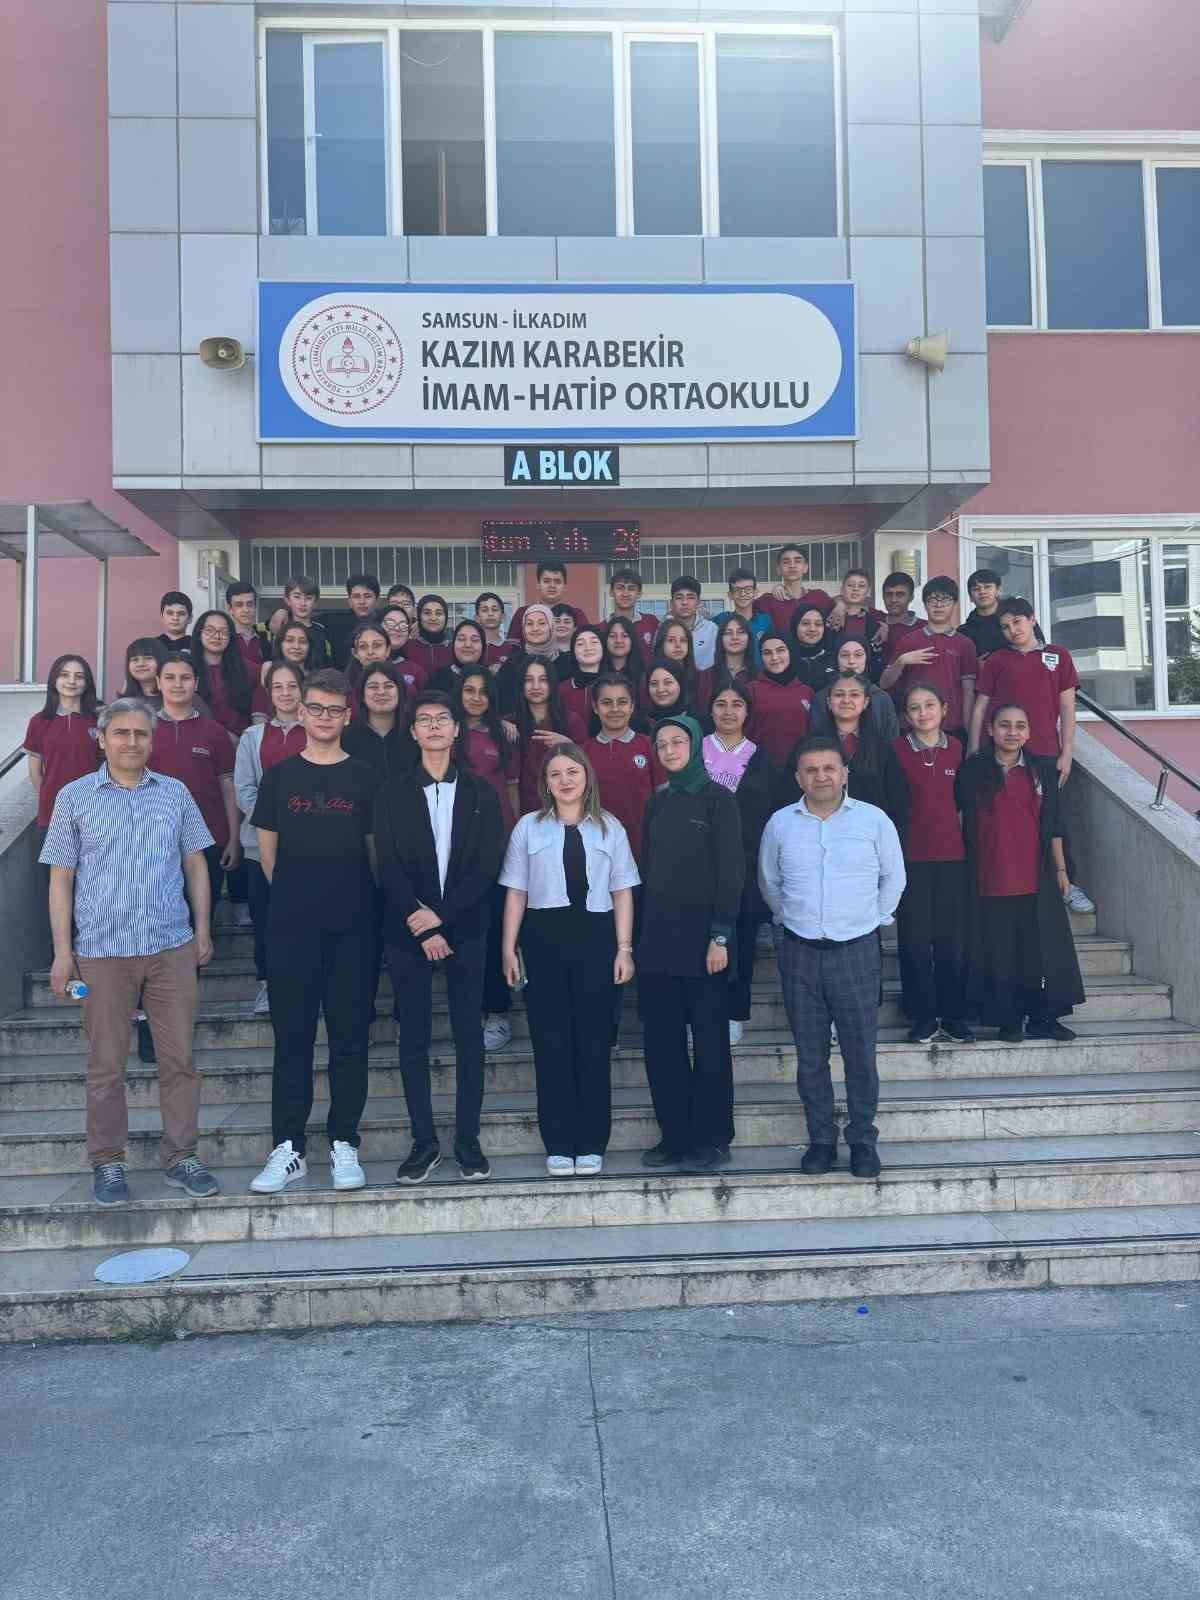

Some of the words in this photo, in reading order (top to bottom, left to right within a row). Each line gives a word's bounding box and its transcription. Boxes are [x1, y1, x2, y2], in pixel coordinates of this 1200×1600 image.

[422, 313, 498, 329] SAMSUN
[513, 309, 587, 329] İLKADIM
[421, 340, 514, 368] KAZIM
[523, 333, 685, 368] KARABEKİR
[422, 375, 617, 411] İMAM-HATİP
[625, 381, 811, 411] ORTAOKULU
[511, 450, 532, 480] A
[539, 450, 613, 480] BLOK
